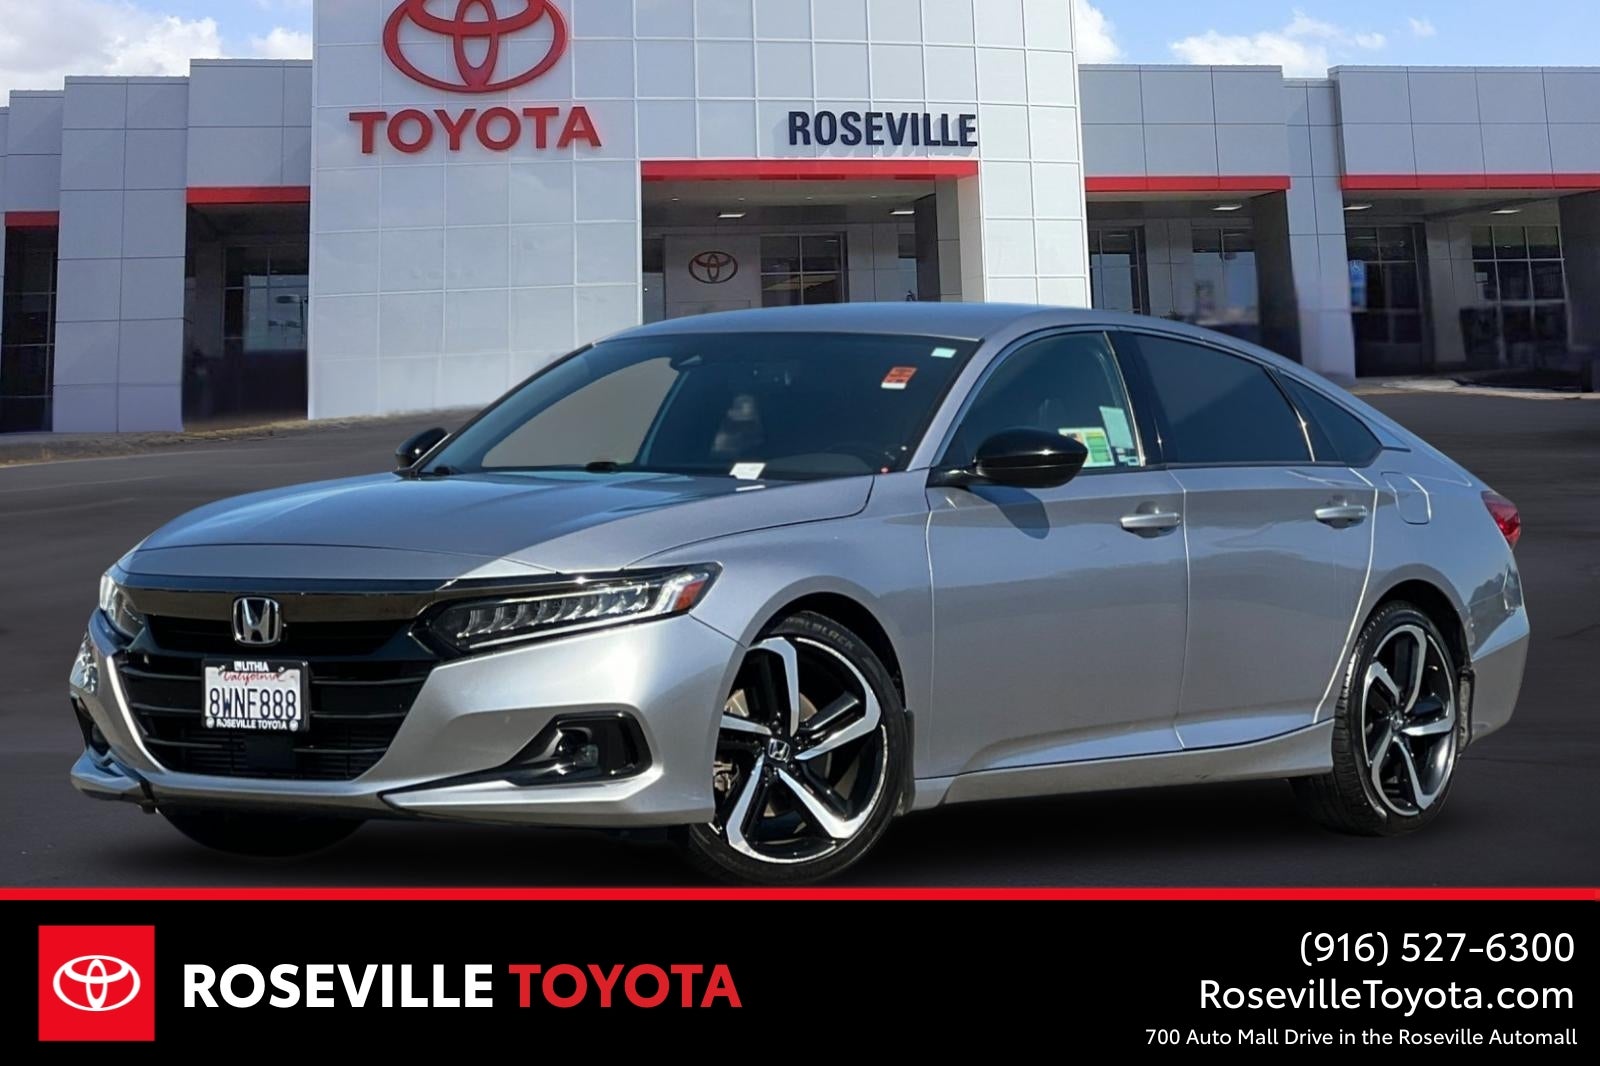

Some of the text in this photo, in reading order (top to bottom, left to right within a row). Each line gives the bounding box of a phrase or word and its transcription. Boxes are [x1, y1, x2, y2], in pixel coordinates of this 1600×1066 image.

[349, 106, 602, 154] TOYOTA
[788, 110, 978, 147] ROSEVILLE
[242, 660, 270, 672] LITHIA
[209, 688, 296, 720] 8WNF888
[216, 718, 287, 730] ROSEVILLE TOYOTA
